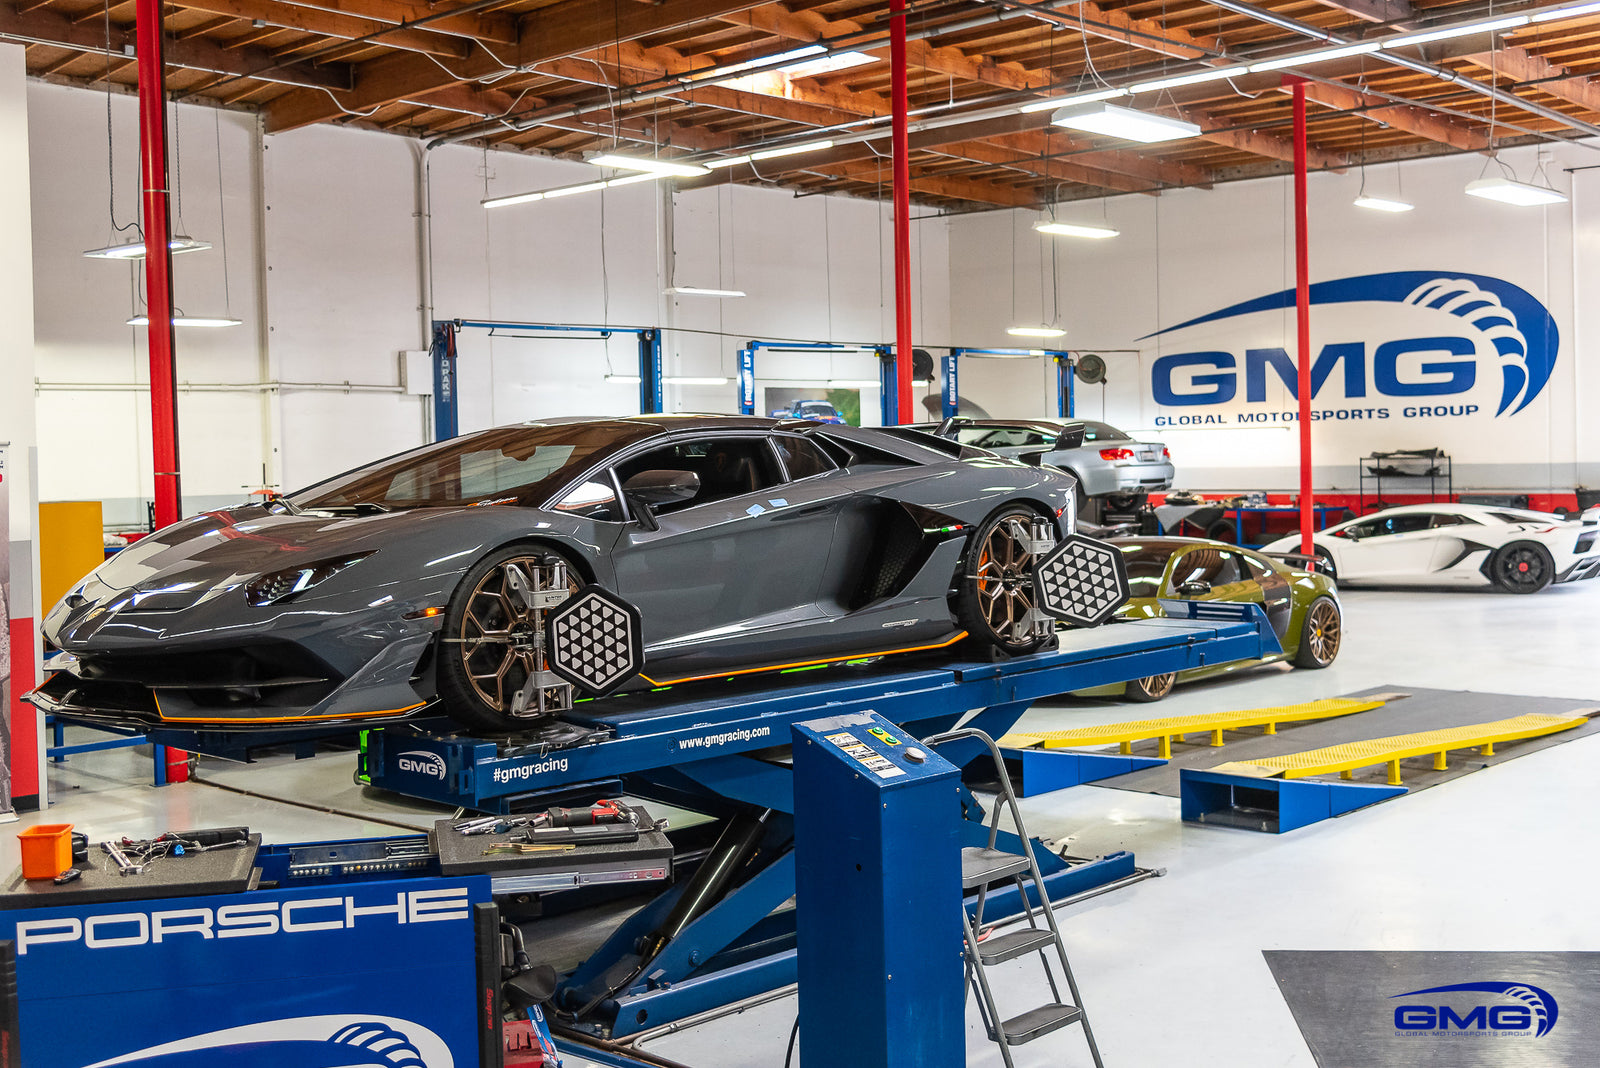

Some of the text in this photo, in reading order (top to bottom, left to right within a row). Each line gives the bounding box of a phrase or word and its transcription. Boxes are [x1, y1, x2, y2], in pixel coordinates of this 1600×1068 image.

[1151, 336, 1477, 407] GMG
[1155, 405, 1479, 426] GLOBAL MOTOSPORTS GROUP
[679, 726, 770, 749] www.gmgracing.com
[399, 758, 439, 775] GMG
[494, 758, 568, 783] #gmgracing
[16, 887, 469, 955] PORSCHE
